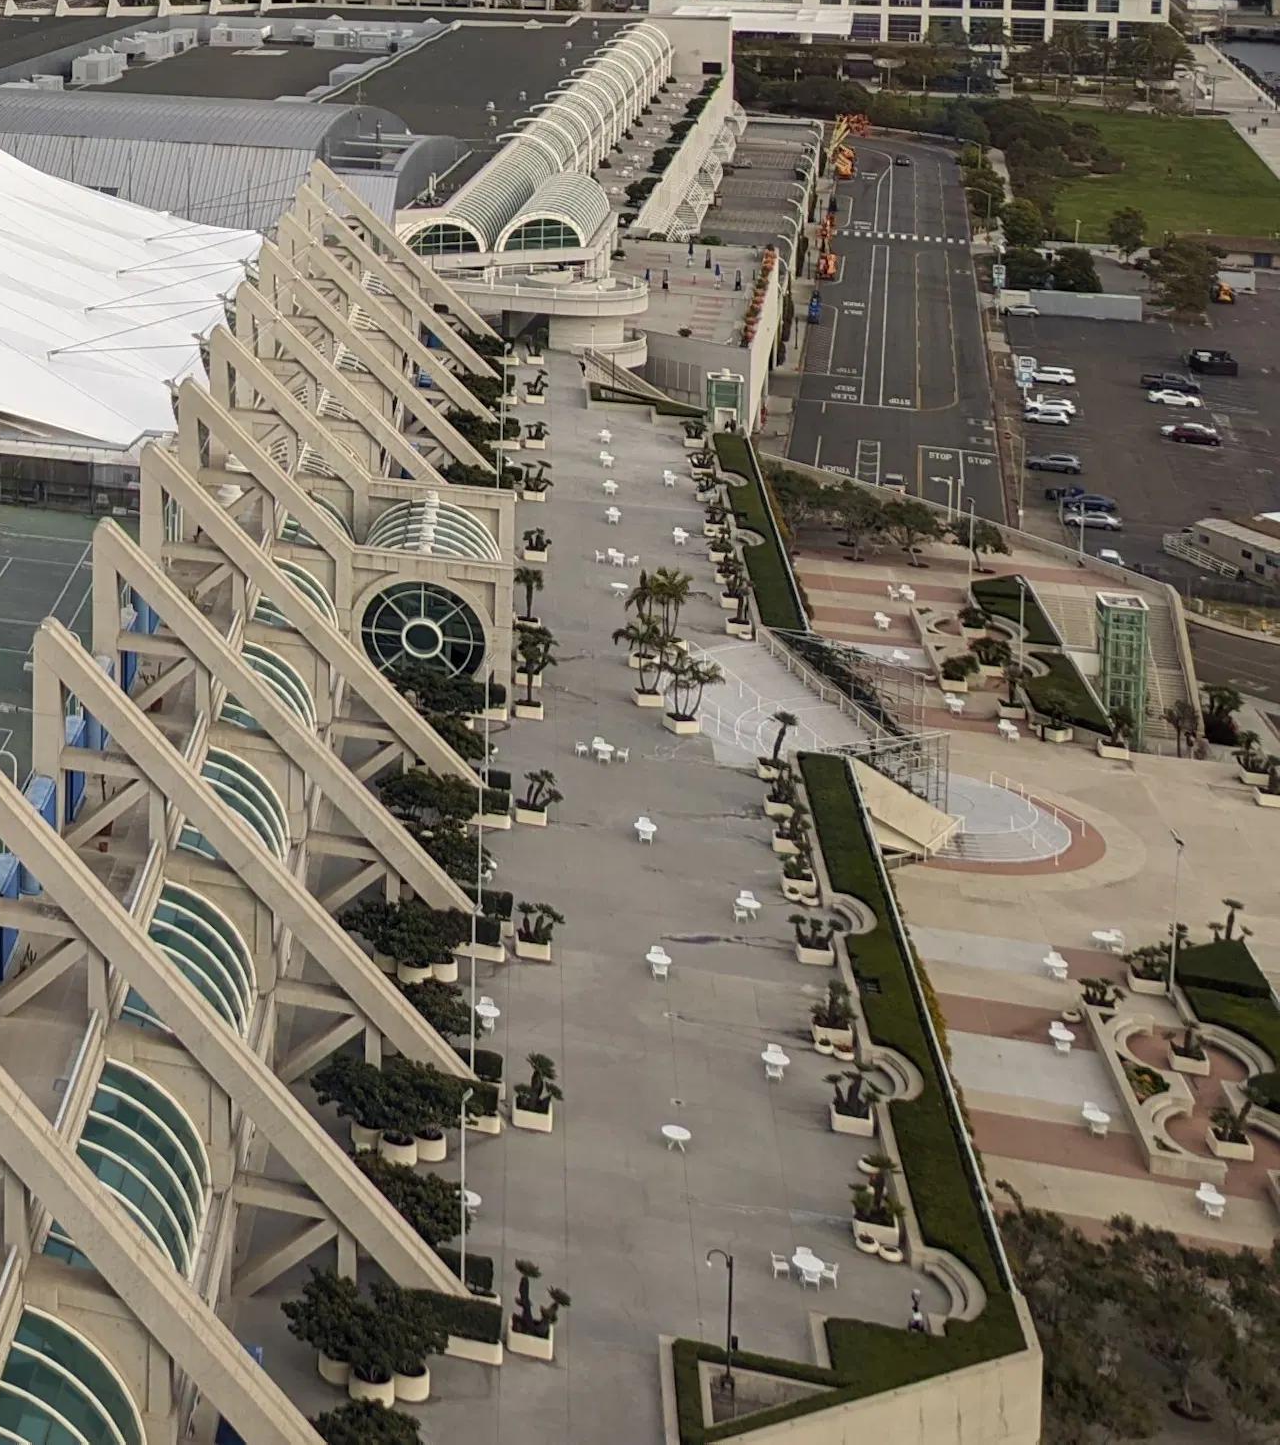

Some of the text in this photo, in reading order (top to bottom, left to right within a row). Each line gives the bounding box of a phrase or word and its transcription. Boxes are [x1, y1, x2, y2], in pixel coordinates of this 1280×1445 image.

[888, 397, 912, 406] STOP
[928, 451, 953, 461] STOP
[967, 456, 992, 466] STOP
